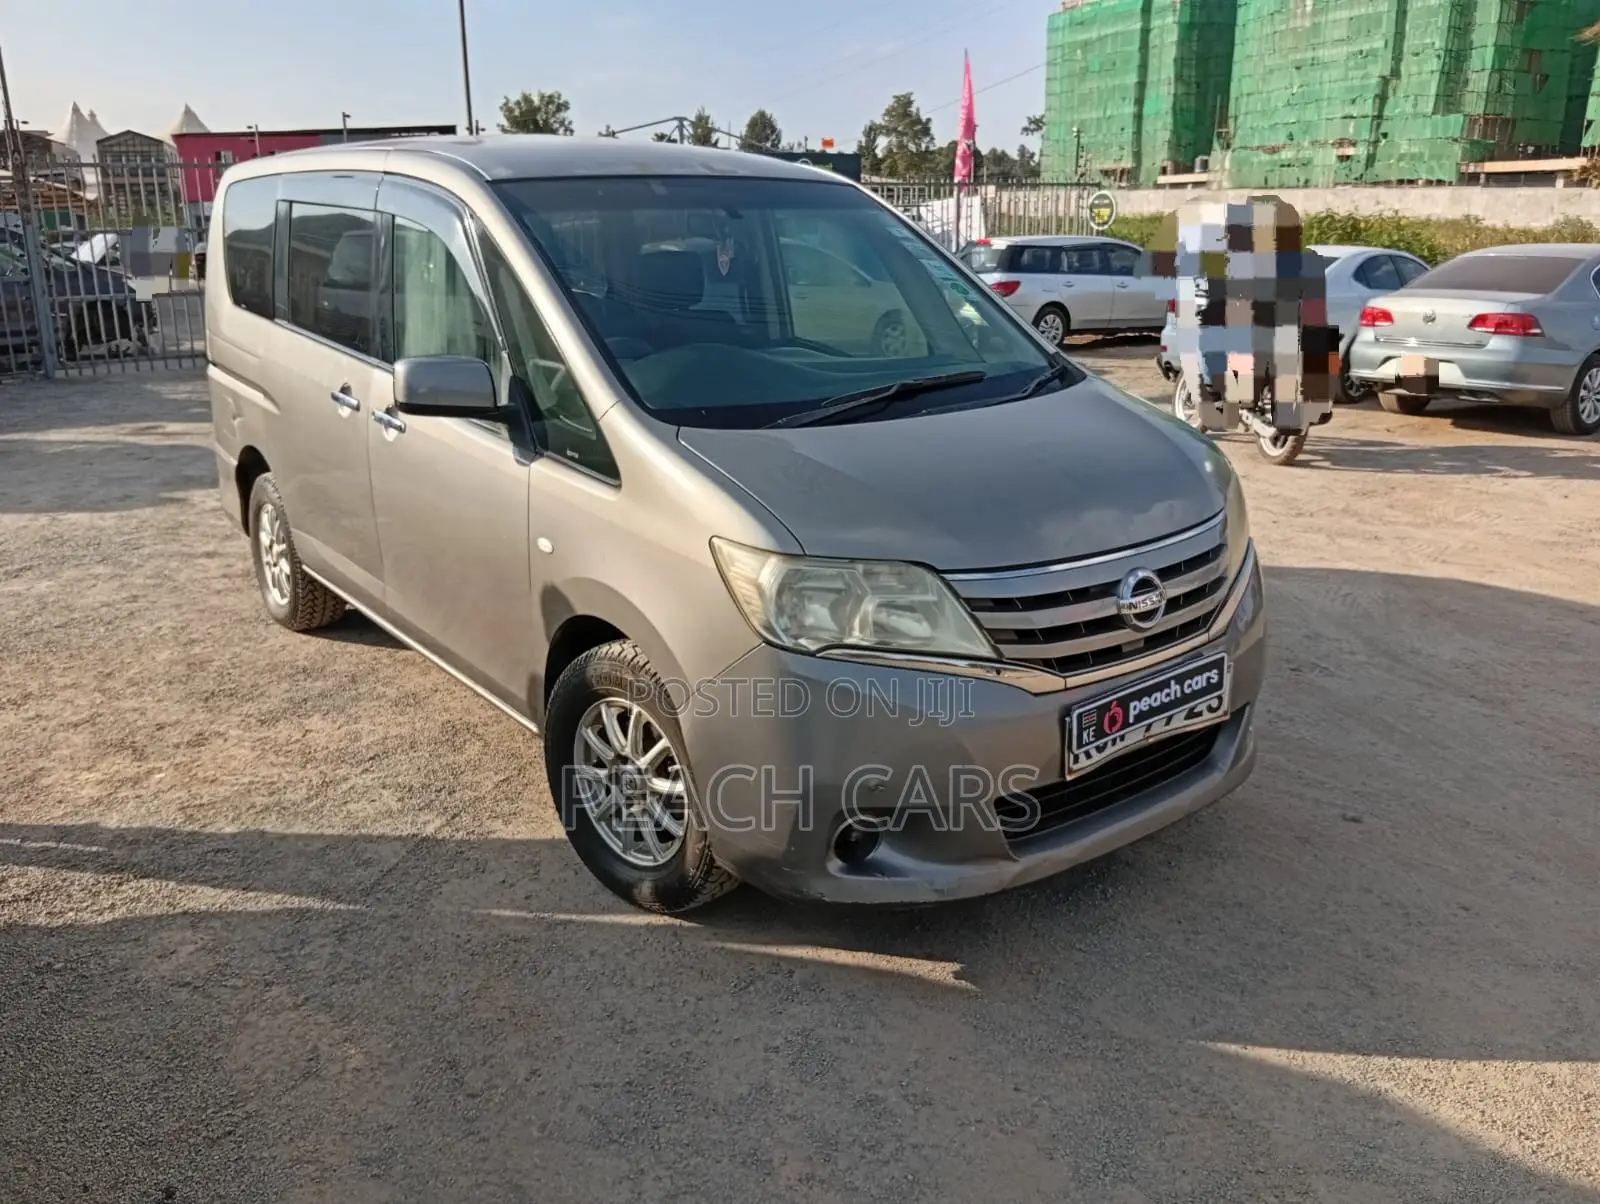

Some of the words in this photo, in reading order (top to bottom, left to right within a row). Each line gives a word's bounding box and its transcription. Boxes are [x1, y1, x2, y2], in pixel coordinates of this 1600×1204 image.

[1128, 679, 1182, 723] peach
[1183, 668, 1219, 694] cars
[1082, 726, 1096, 745] KE
